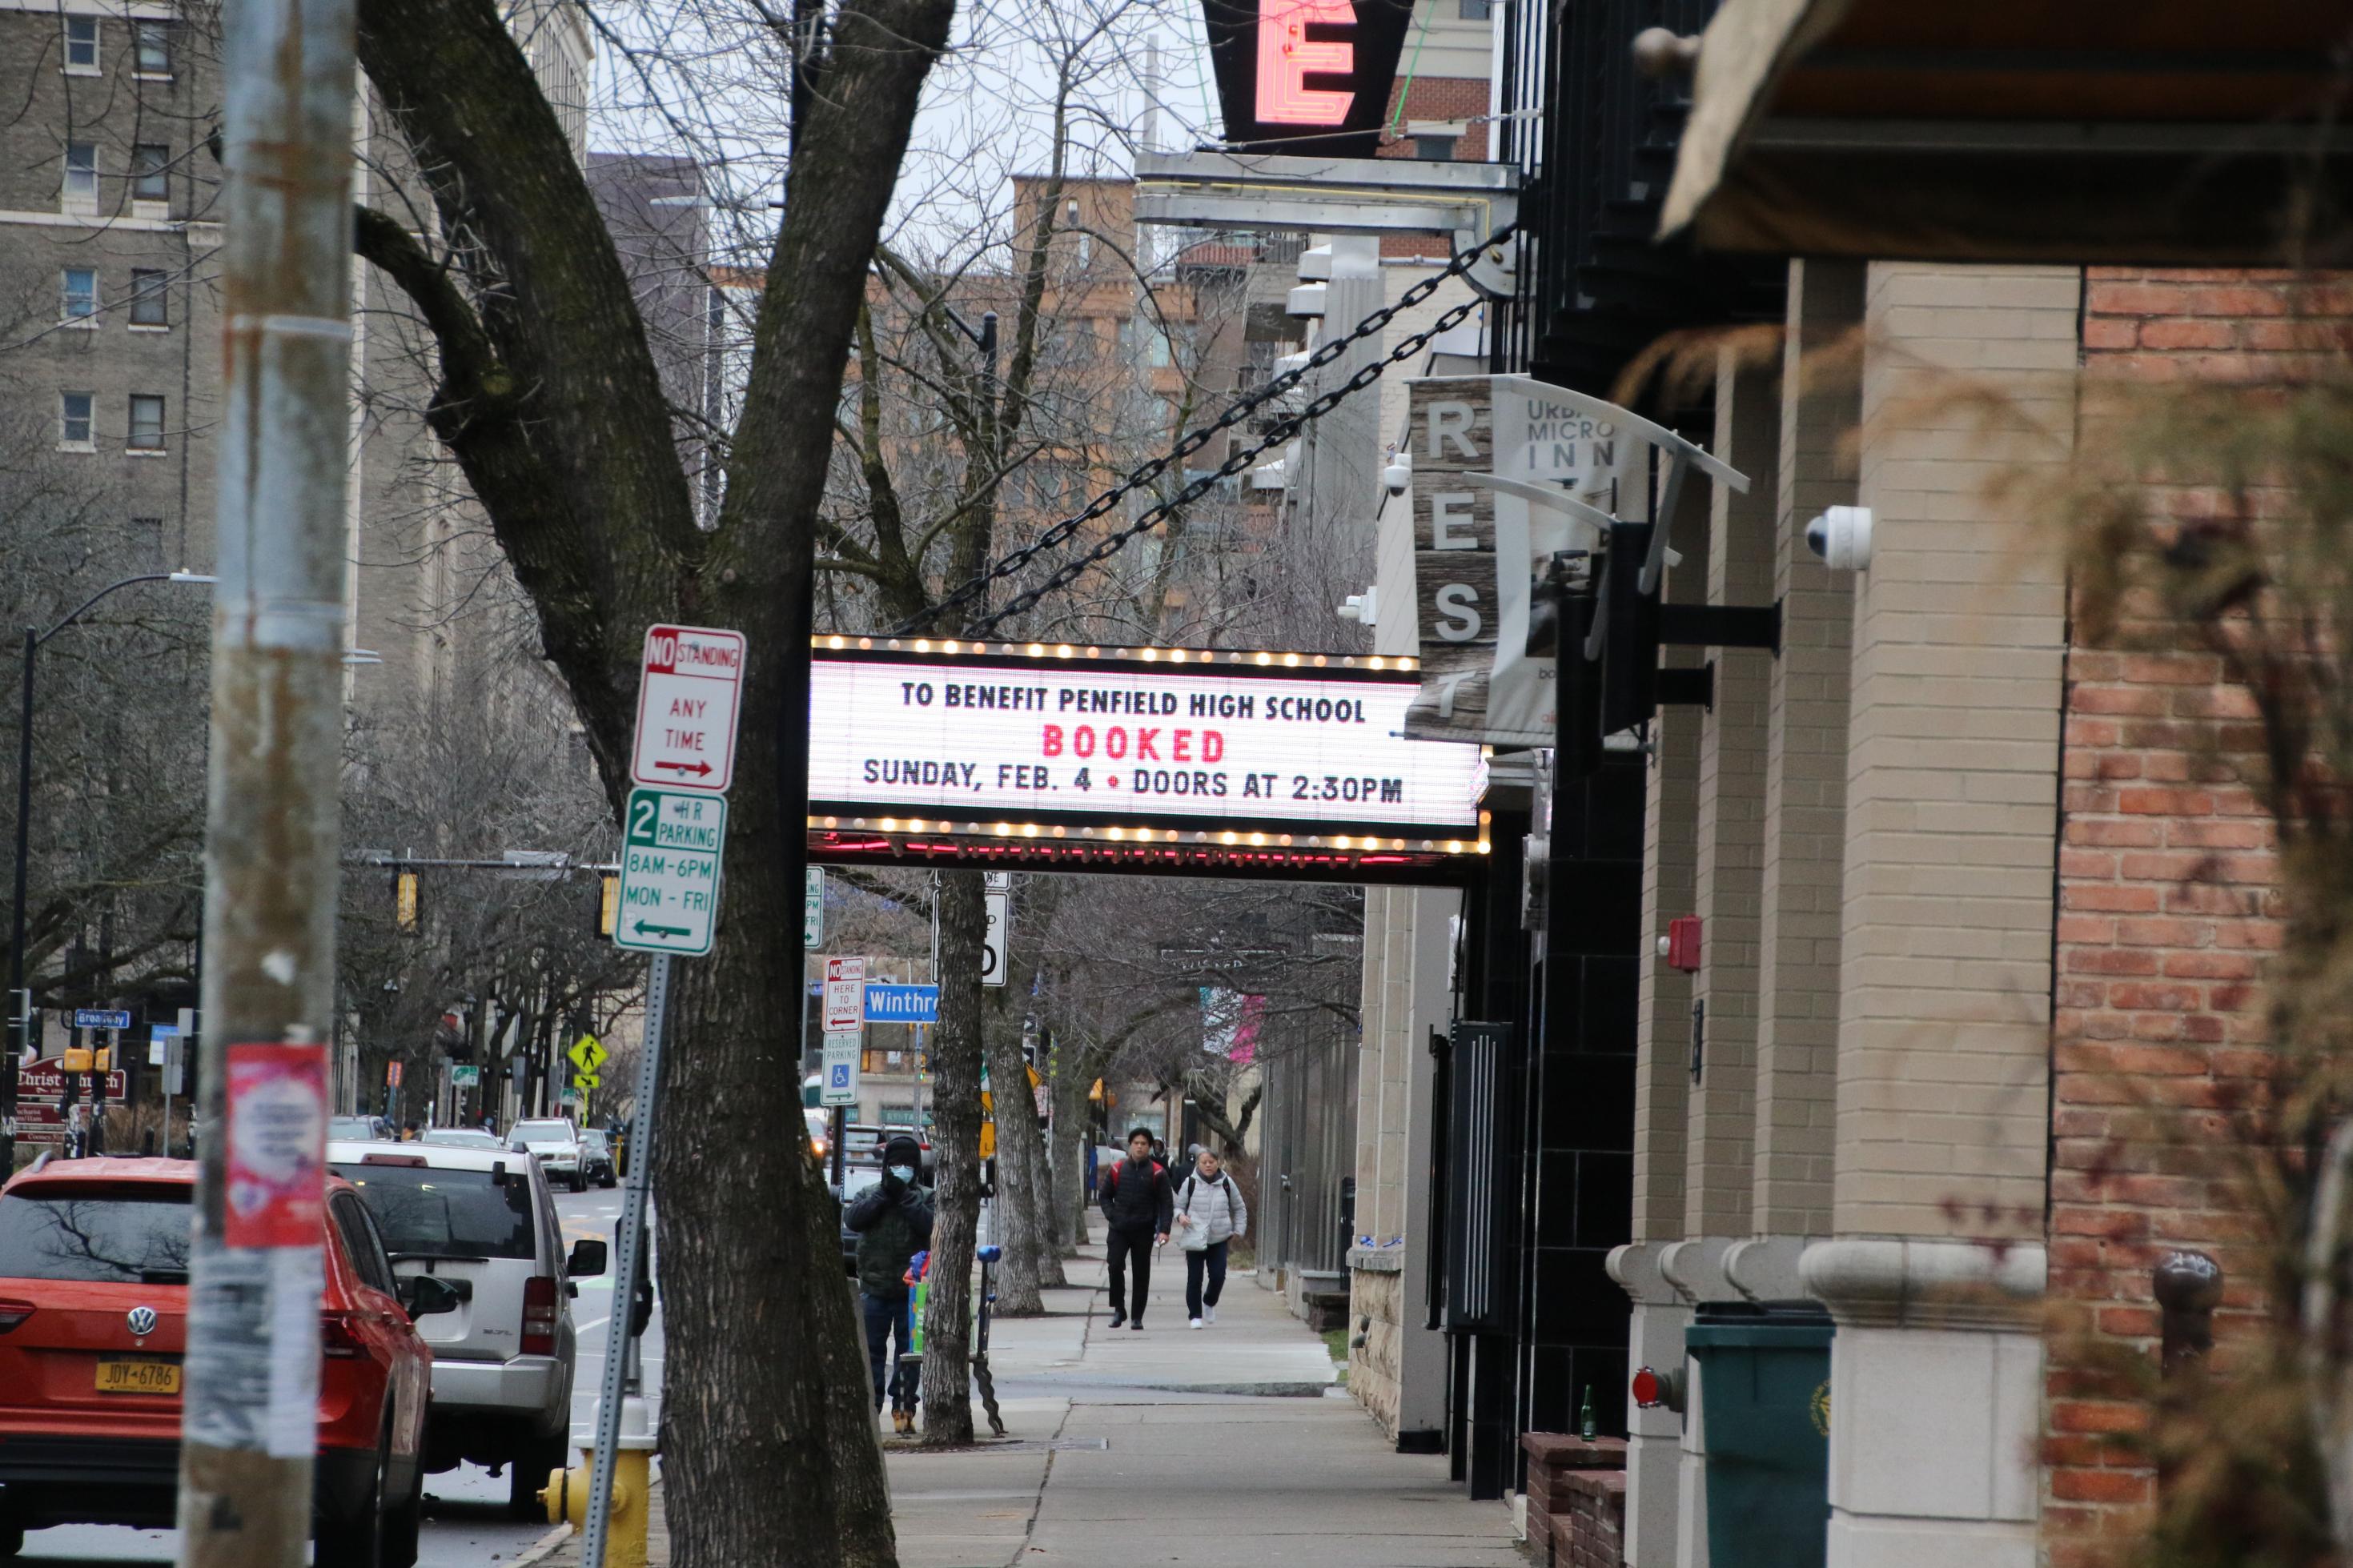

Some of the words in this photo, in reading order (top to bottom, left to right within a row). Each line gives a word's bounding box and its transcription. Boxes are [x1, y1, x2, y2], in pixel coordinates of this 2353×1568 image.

[1528, 420, 1615, 441] MICRO
[1528, 441, 1614, 470] INN
[648, 635, 675, 668] NO
[677, 641, 738, 668] STANDING
[669, 697, 708, 719] ANY
[901, 681, 934, 707] TO
[945, 684, 1048, 711] BENEFIT
[1058, 688, 1178, 716] PENFIELD
[1190, 693, 1255, 720] HIGH
[1265, 696, 1366, 723] SCHOOL
[665, 728, 705, 752] TIME
[1042, 723, 1225, 763] BOOKED
[863, 758, 983, 792] SUNDAY,
[998, 764, 1058, 790] FEB.
[1074, 767, 1092, 792] 4
[1133, 768, 1228, 796] DOORS
[1243, 772, 1279, 799] AT
[1292, 775, 1403, 804] 2:30PM
[632, 799, 656, 838] 2
[659, 821, 717, 848] PARKING
[628, 852, 713, 880] 8AM-6PM
[624, 884, 661, 908] MON
[683, 890, 709, 912] FRI
[829, 964, 841, 978] NO
[841, 964, 862, 975] STANDING
[834, 984, 856, 993] HERE
[840, 995, 849, 1004] TO
[829, 1006, 858, 1016] CORNER
[827, 1049, 857, 1061] PARKING
[828, 1037, 857, 1048] RESERVED
